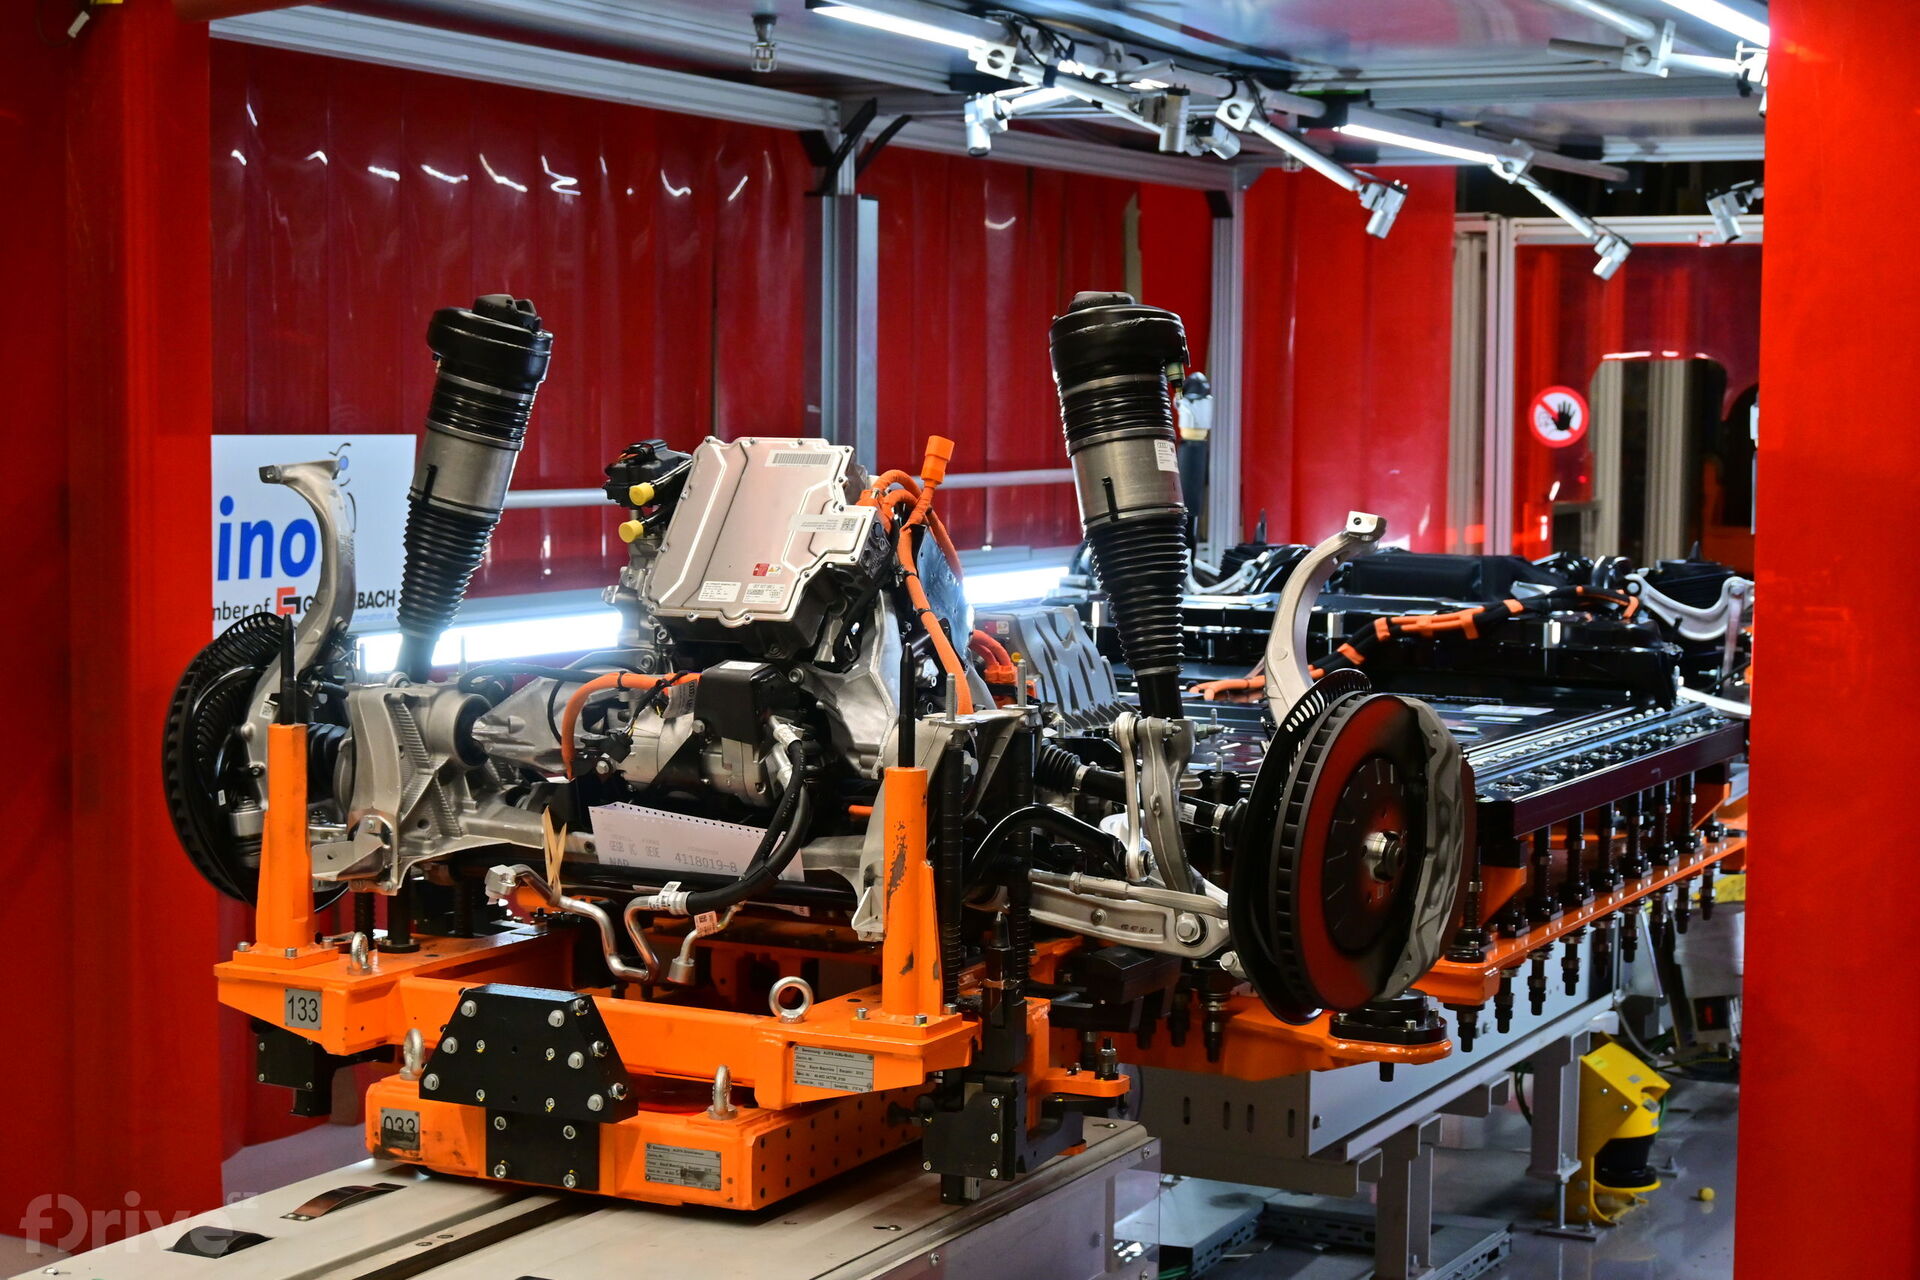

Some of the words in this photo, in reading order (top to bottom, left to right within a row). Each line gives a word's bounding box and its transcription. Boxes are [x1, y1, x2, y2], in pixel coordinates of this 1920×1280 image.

[218, 495, 317, 581] ino
[253, 597, 271, 614] of
[674, 852, 738, 873] 4118019-8
[288, 995, 319, 1023] 133
[383, 1115, 417, 1142] 033
